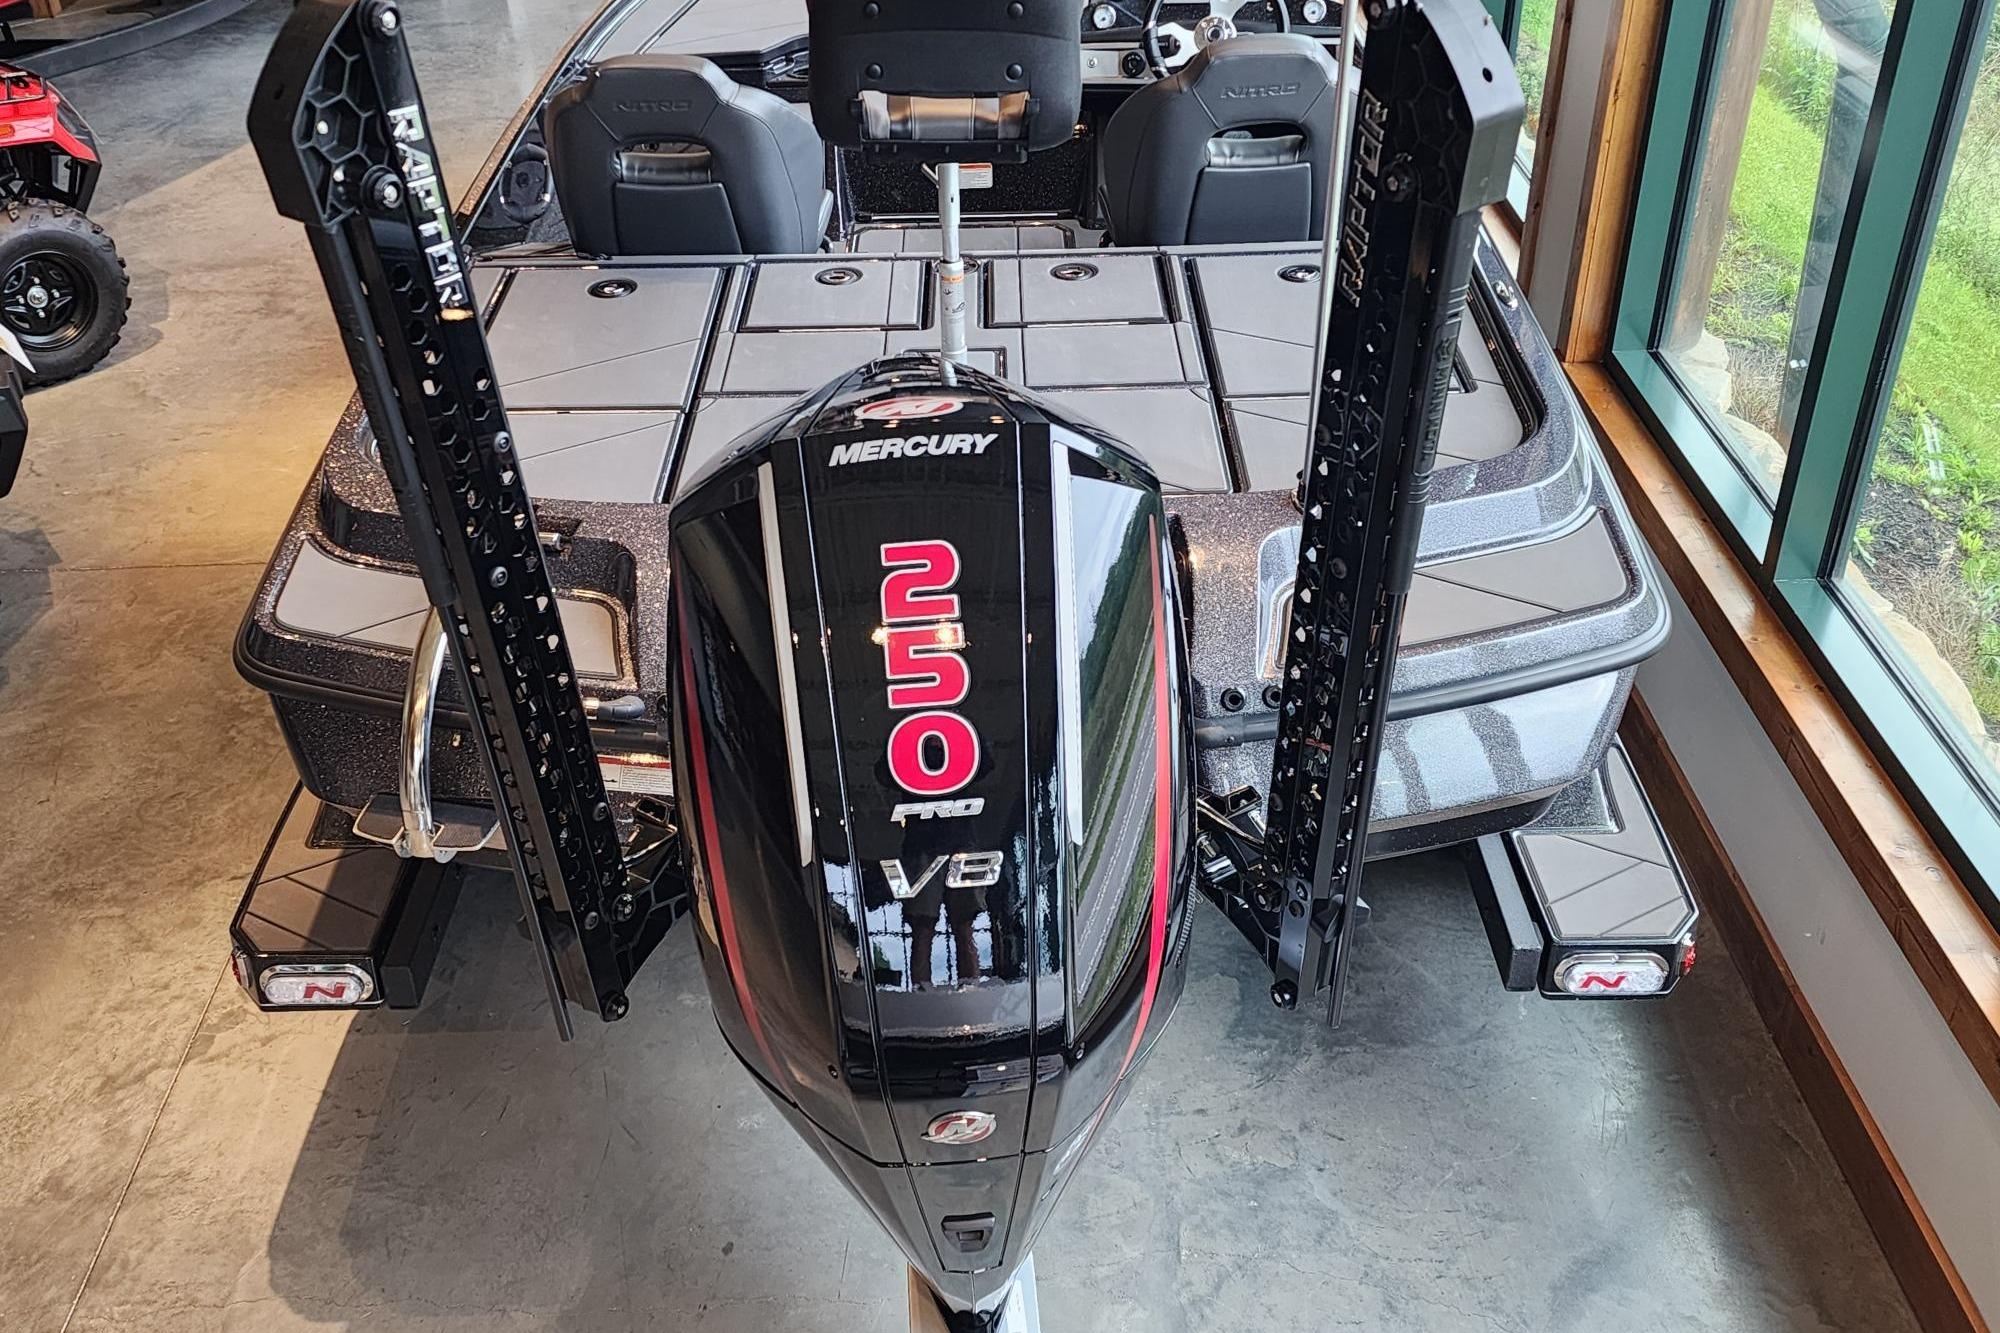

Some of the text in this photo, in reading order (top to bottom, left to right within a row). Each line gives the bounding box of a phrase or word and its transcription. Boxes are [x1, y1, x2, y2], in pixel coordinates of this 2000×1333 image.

[387, 104, 471, 309] RAPTOR
[1336, 89, 1389, 309] RAPTOR
[828, 433, 999, 467] MERCURY
[880, 539, 981, 796] 250
[890, 797, 985, 822] PRO
[879, 850, 1004, 900] V8
